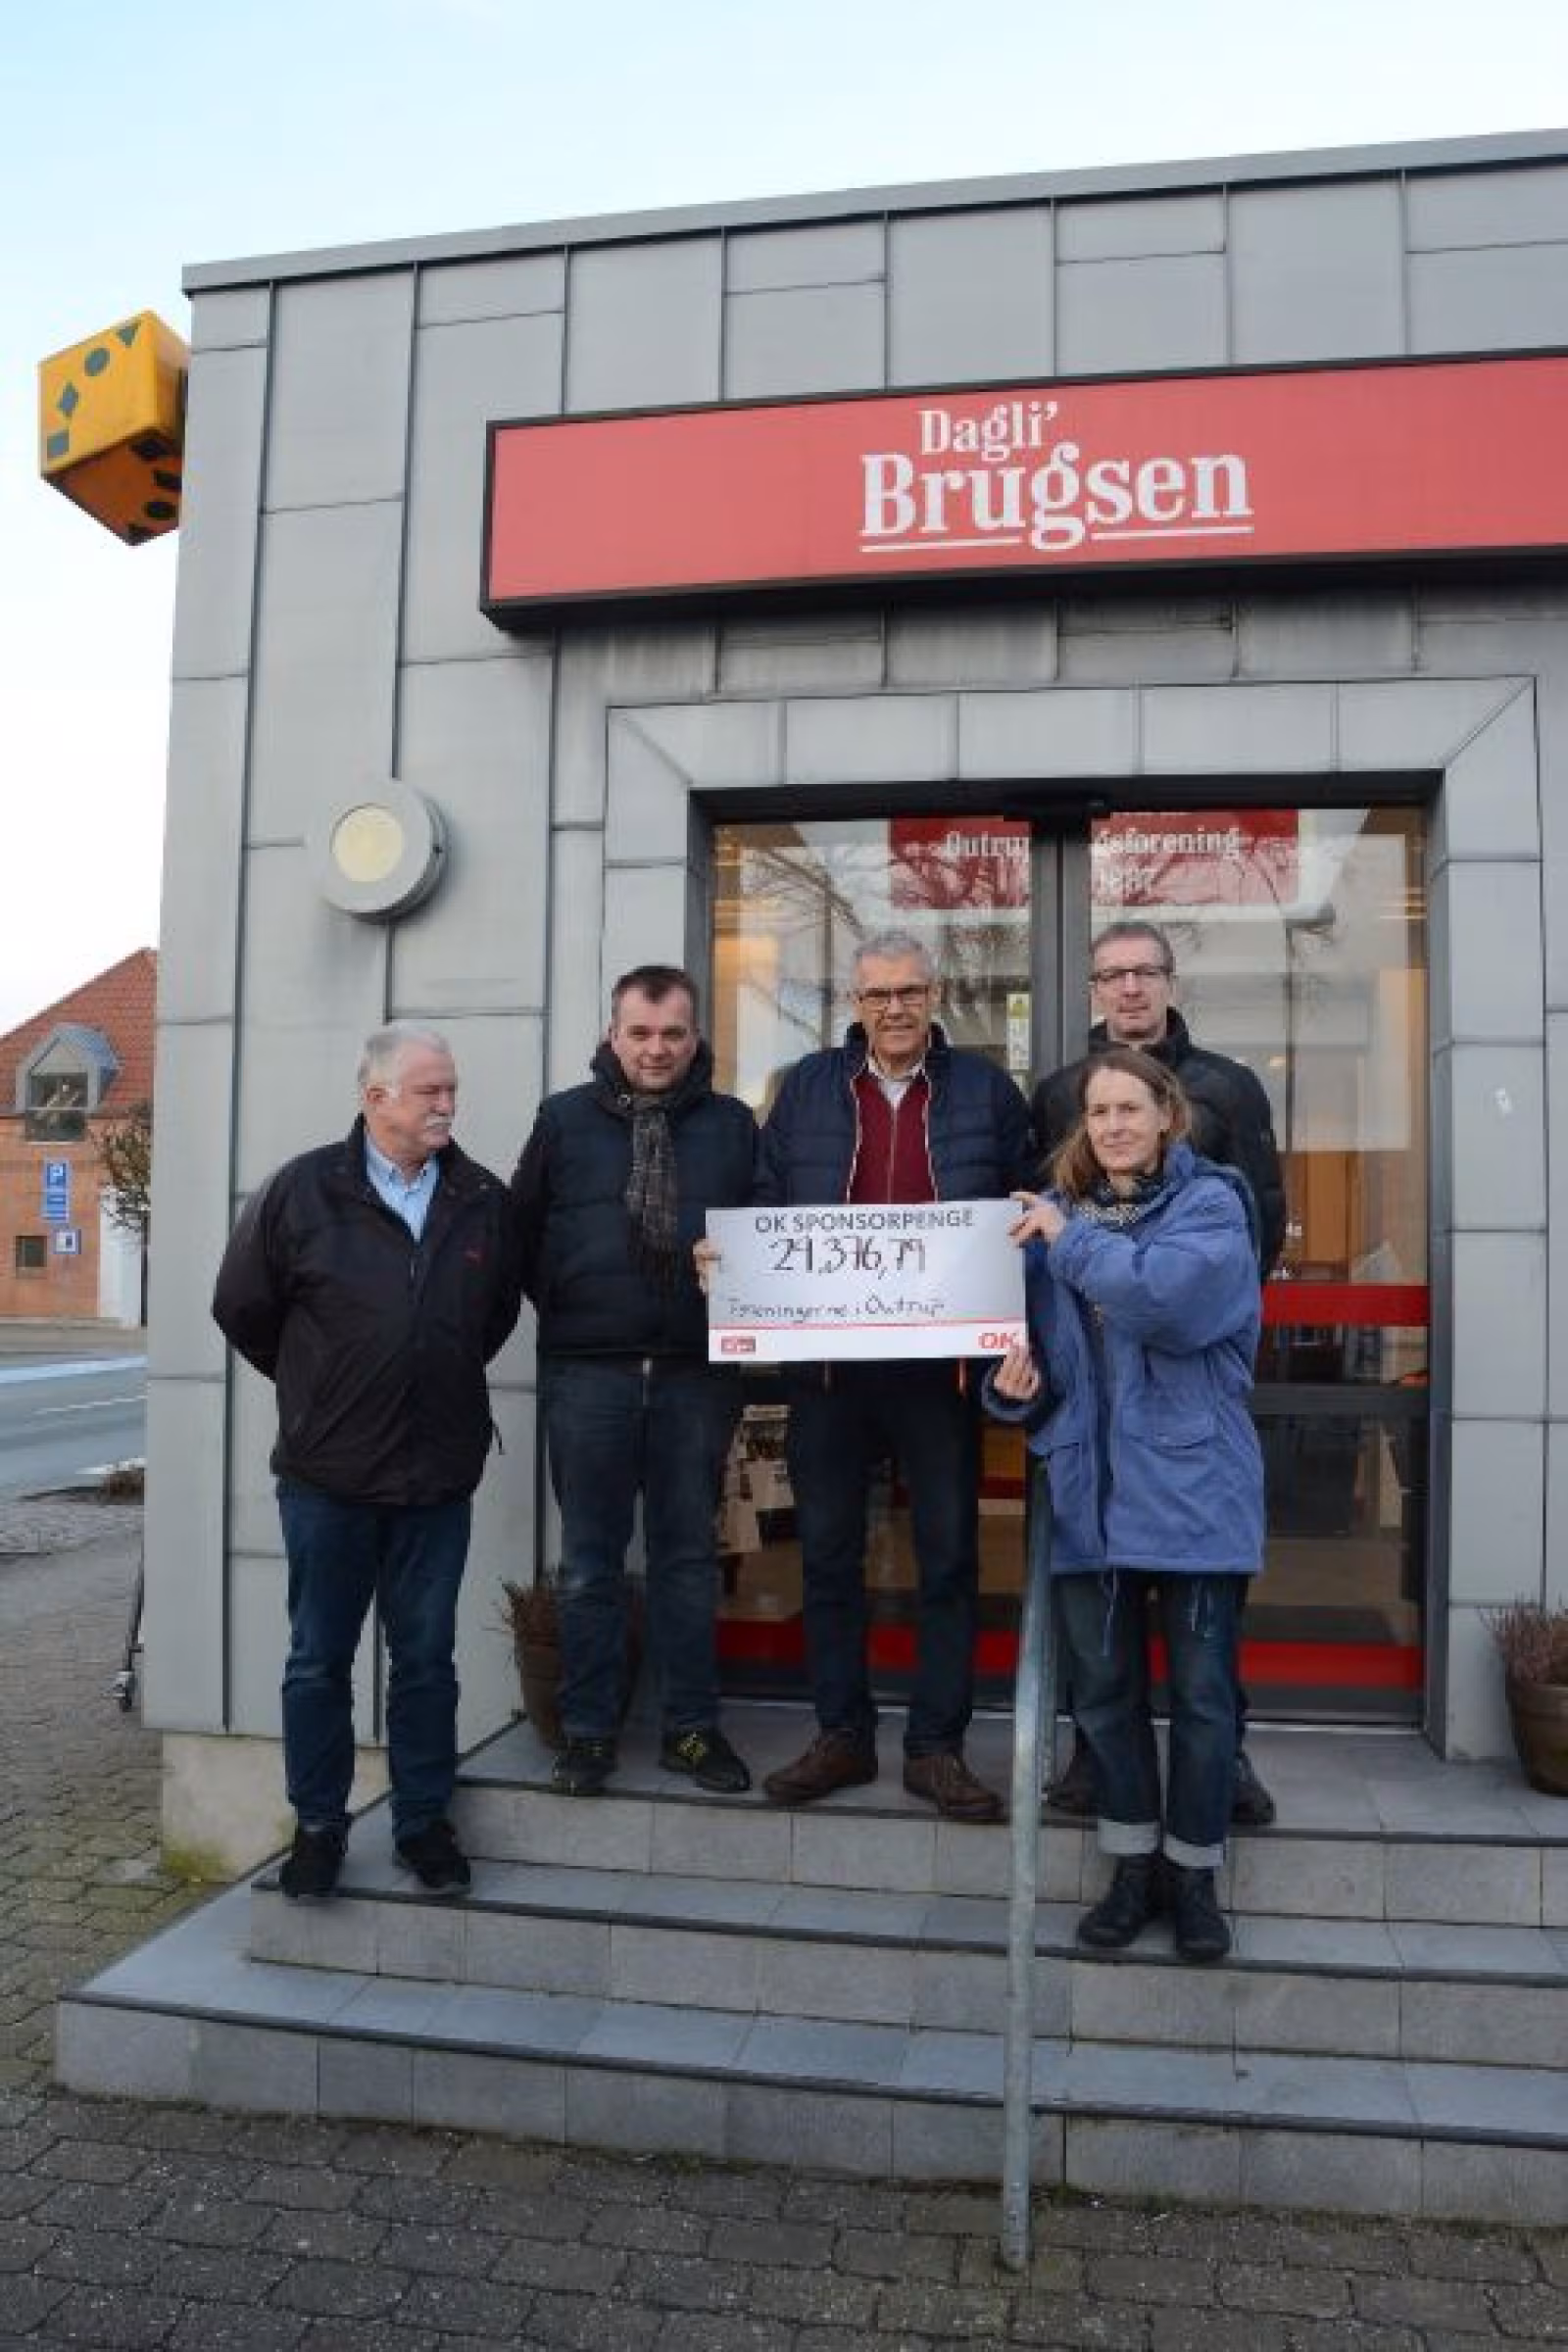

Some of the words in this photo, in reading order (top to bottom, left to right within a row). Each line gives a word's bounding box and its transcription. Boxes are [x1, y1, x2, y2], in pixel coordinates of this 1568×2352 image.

[917, 400, 1058, 462] Dagli'
[859, 442, 1255, 552] Brugsen
[755, 1212, 787, 1233] OK
[792, 1209, 974, 1232] SPONSORPENGE
[978, 1332, 1021, 1349] OK
